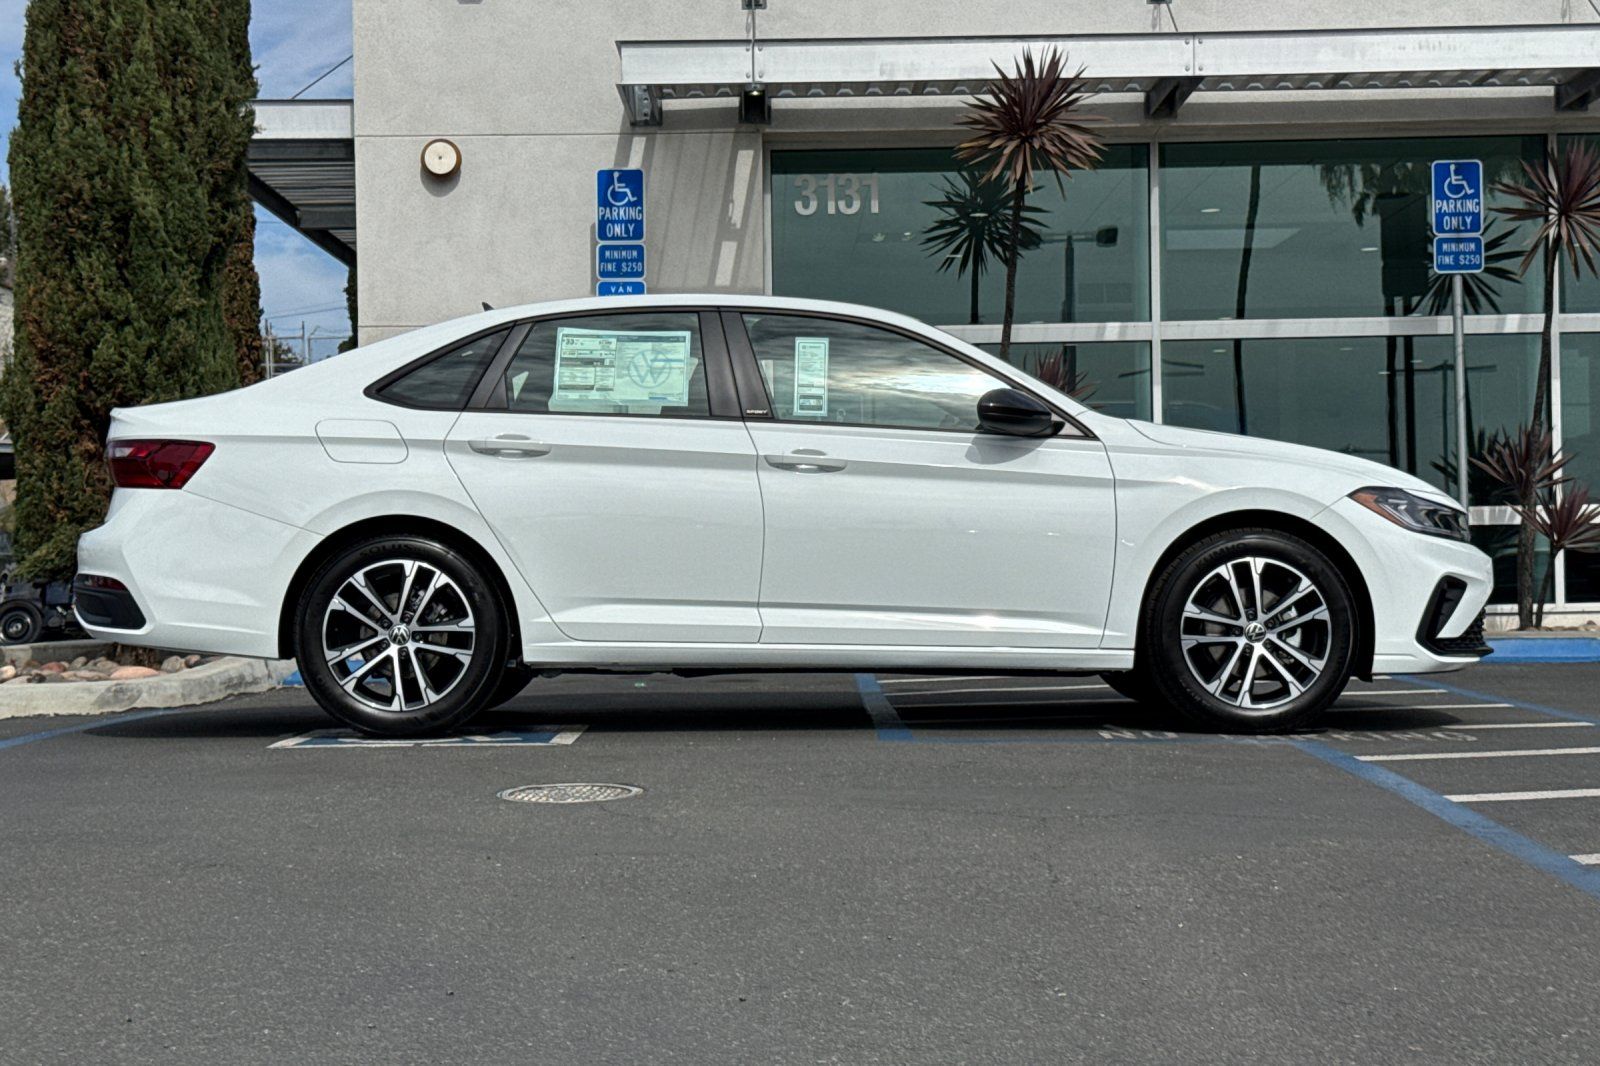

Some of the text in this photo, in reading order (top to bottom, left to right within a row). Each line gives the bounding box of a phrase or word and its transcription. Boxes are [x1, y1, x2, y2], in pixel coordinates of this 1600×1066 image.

[794, 173, 879, 216] 3131
[1435, 199, 1480, 213] PARKING
[598, 206, 643, 221] PARKING
[1443, 215, 1473, 230] ONLY
[606, 223, 635, 238] ONLY
[1442, 242, 1476, 253] MINIMUM
[605, 249, 638, 260] MINIMUM
[1437, 254, 1481, 265] FINE $250
[600, 261, 643, 273] FINE $250
[610, 285, 633, 294] VAN
